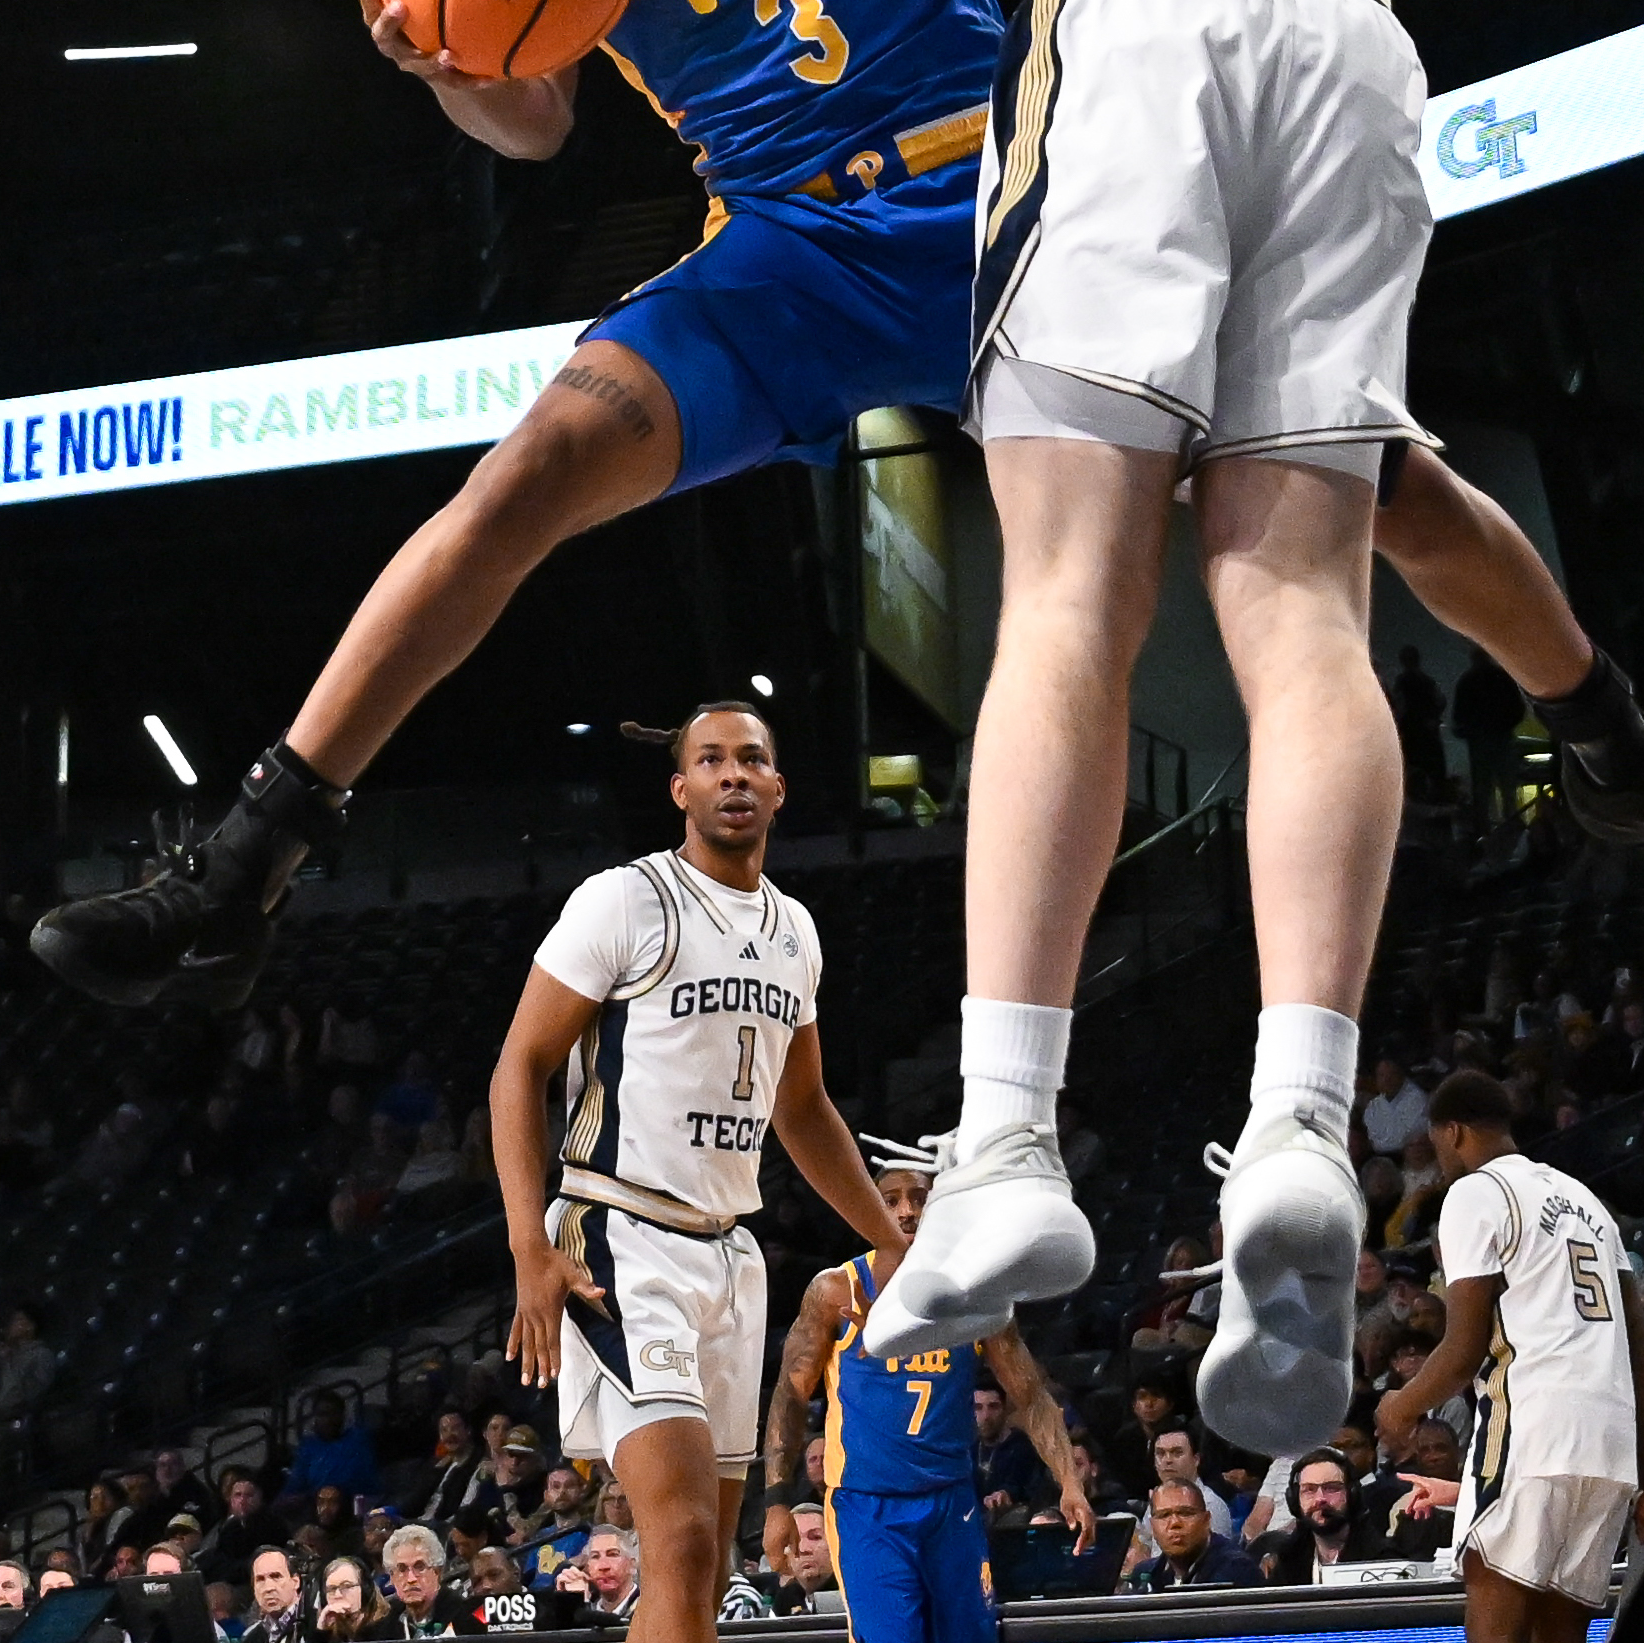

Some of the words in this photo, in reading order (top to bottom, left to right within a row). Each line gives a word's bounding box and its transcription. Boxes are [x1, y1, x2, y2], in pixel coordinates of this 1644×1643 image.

[56, 395, 186, 477] NOW!
[670, 976, 801, 1030] GEORGIA
[731, 1025, 757, 1102] 1
[1566, 1237, 1614, 1322] 5
[906, 1379, 933, 1436] 7
[484, 1593, 537, 1623] POSS
